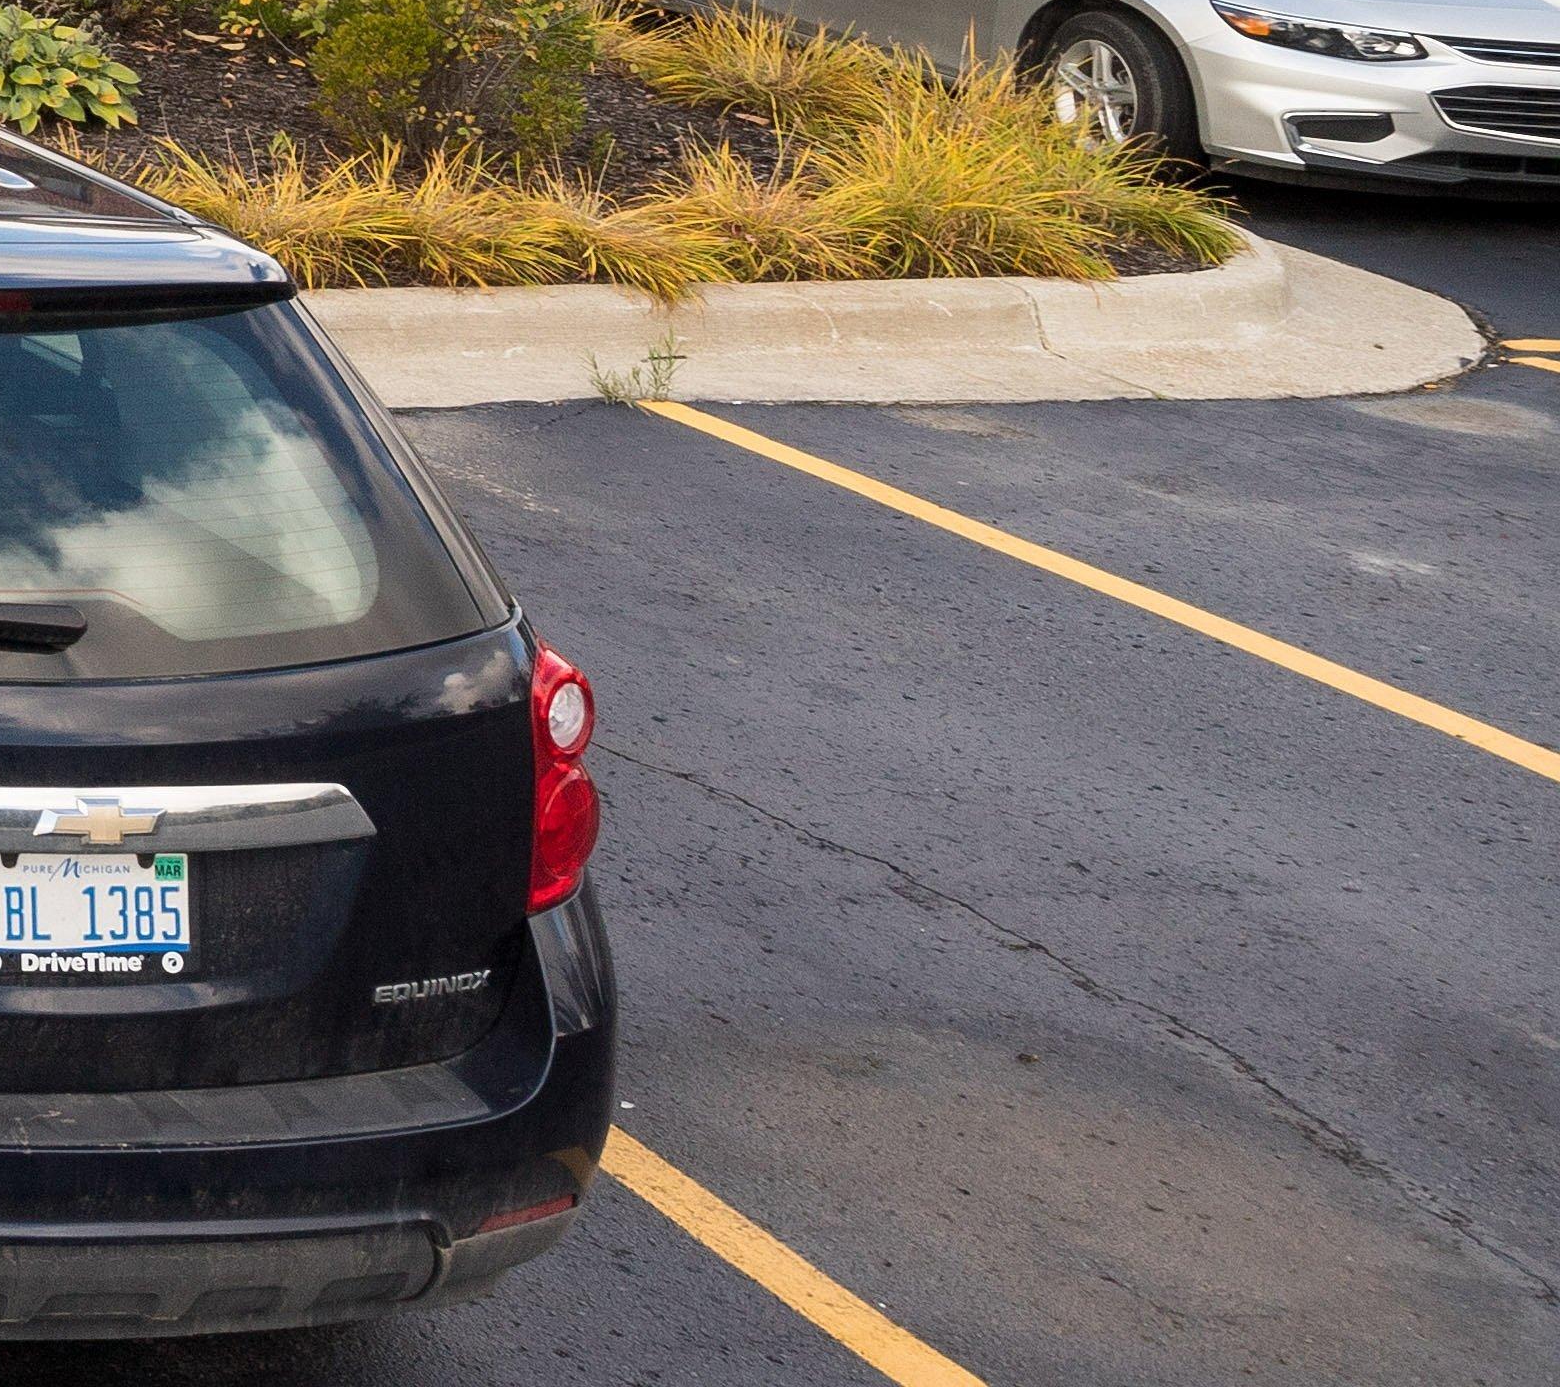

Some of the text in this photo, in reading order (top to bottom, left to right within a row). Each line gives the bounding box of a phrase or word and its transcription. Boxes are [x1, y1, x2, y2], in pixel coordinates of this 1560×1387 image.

[22, 858, 131, 882] PURE MICHIGAN
[154, 864, 182, 877] MAR
[81, 885, 182, 941] 1385
[21, 952, 143, 973] DriveTime
[374, 969, 492, 1003] EQUINOX
